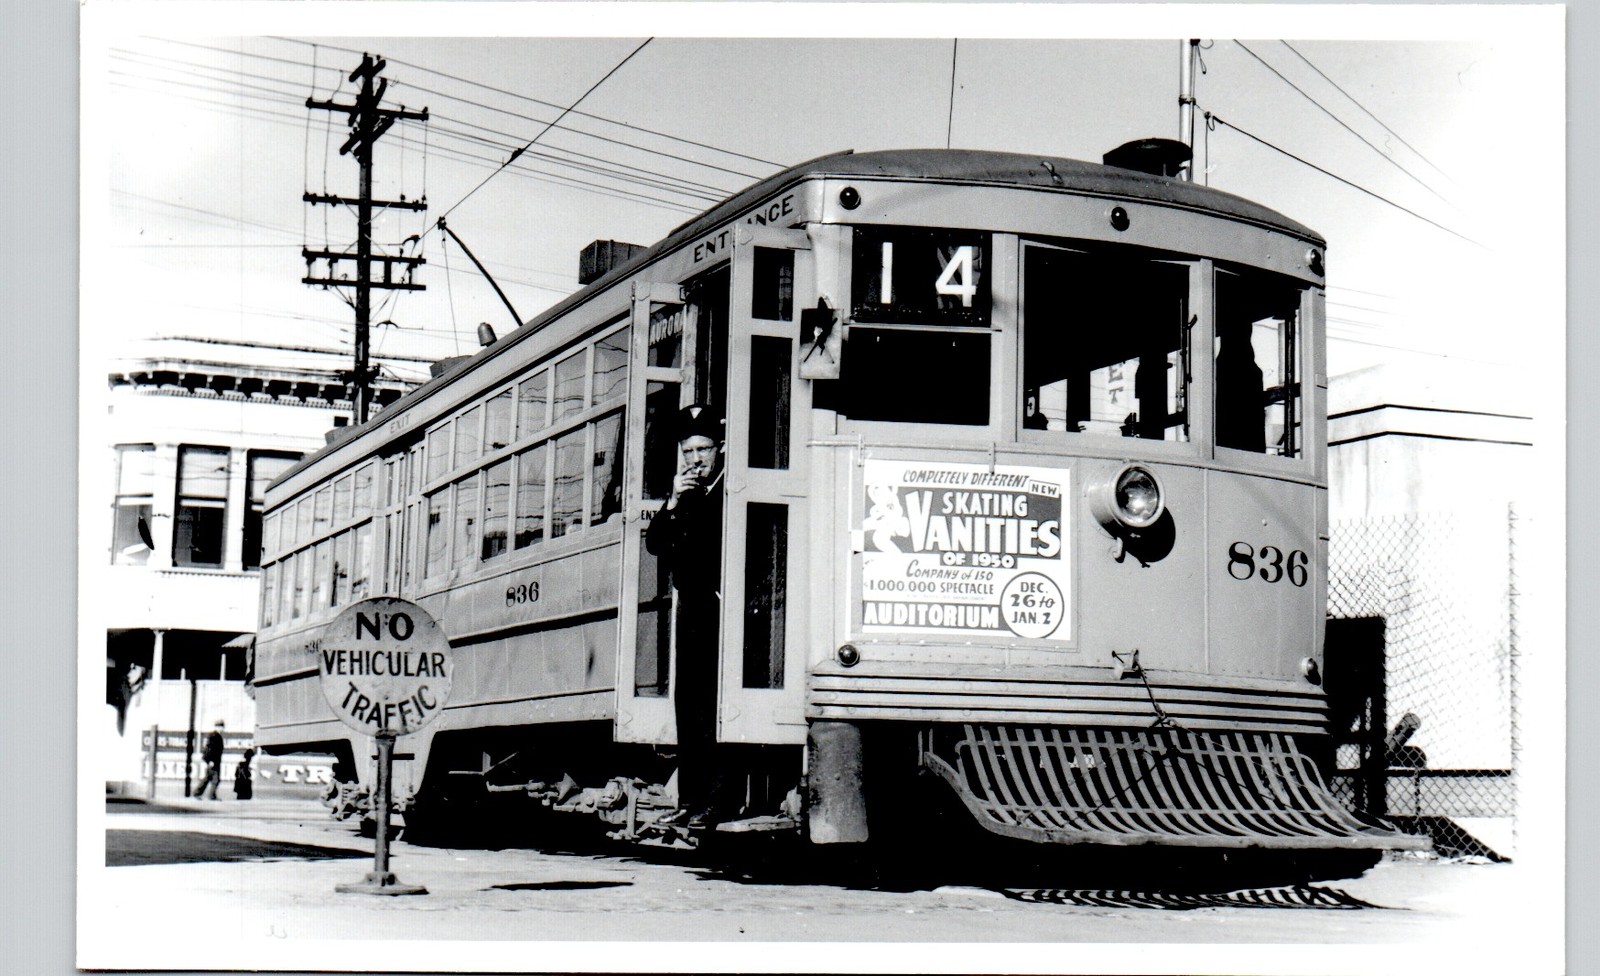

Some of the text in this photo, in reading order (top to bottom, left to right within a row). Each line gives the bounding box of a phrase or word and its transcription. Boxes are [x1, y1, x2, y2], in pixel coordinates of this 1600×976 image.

[693, 195, 794, 263] ENTNCE
[391, 413, 411, 434] EXIT
[903, 470, 1030, 489] COMPLETELY DIFFERENT
[1032, 484, 1058, 496] NEW
[942, 491, 1028, 517] SKATING
[905, 490, 1061, 557] VANITIES
[906, 559, 993, 581] COMPANY of 150
[943, 552, 1015, 569] OF 1950
[1228, 541, 1308, 587] 836
[506, 581, 539, 607] 836
[940, 582, 994, 595] SPECTACLE
[1020, 582, 1048, 594] DEC.
[1011, 594, 1055, 608] 26 to
[356, 612, 414, 641] NO
[864, 602, 998, 629] AUDITORIUM
[1012, 611, 1051, 625] JAN. 2
[323, 650, 446, 678] VEHICULAR
[342, 681, 437, 729] TRAFFIC
